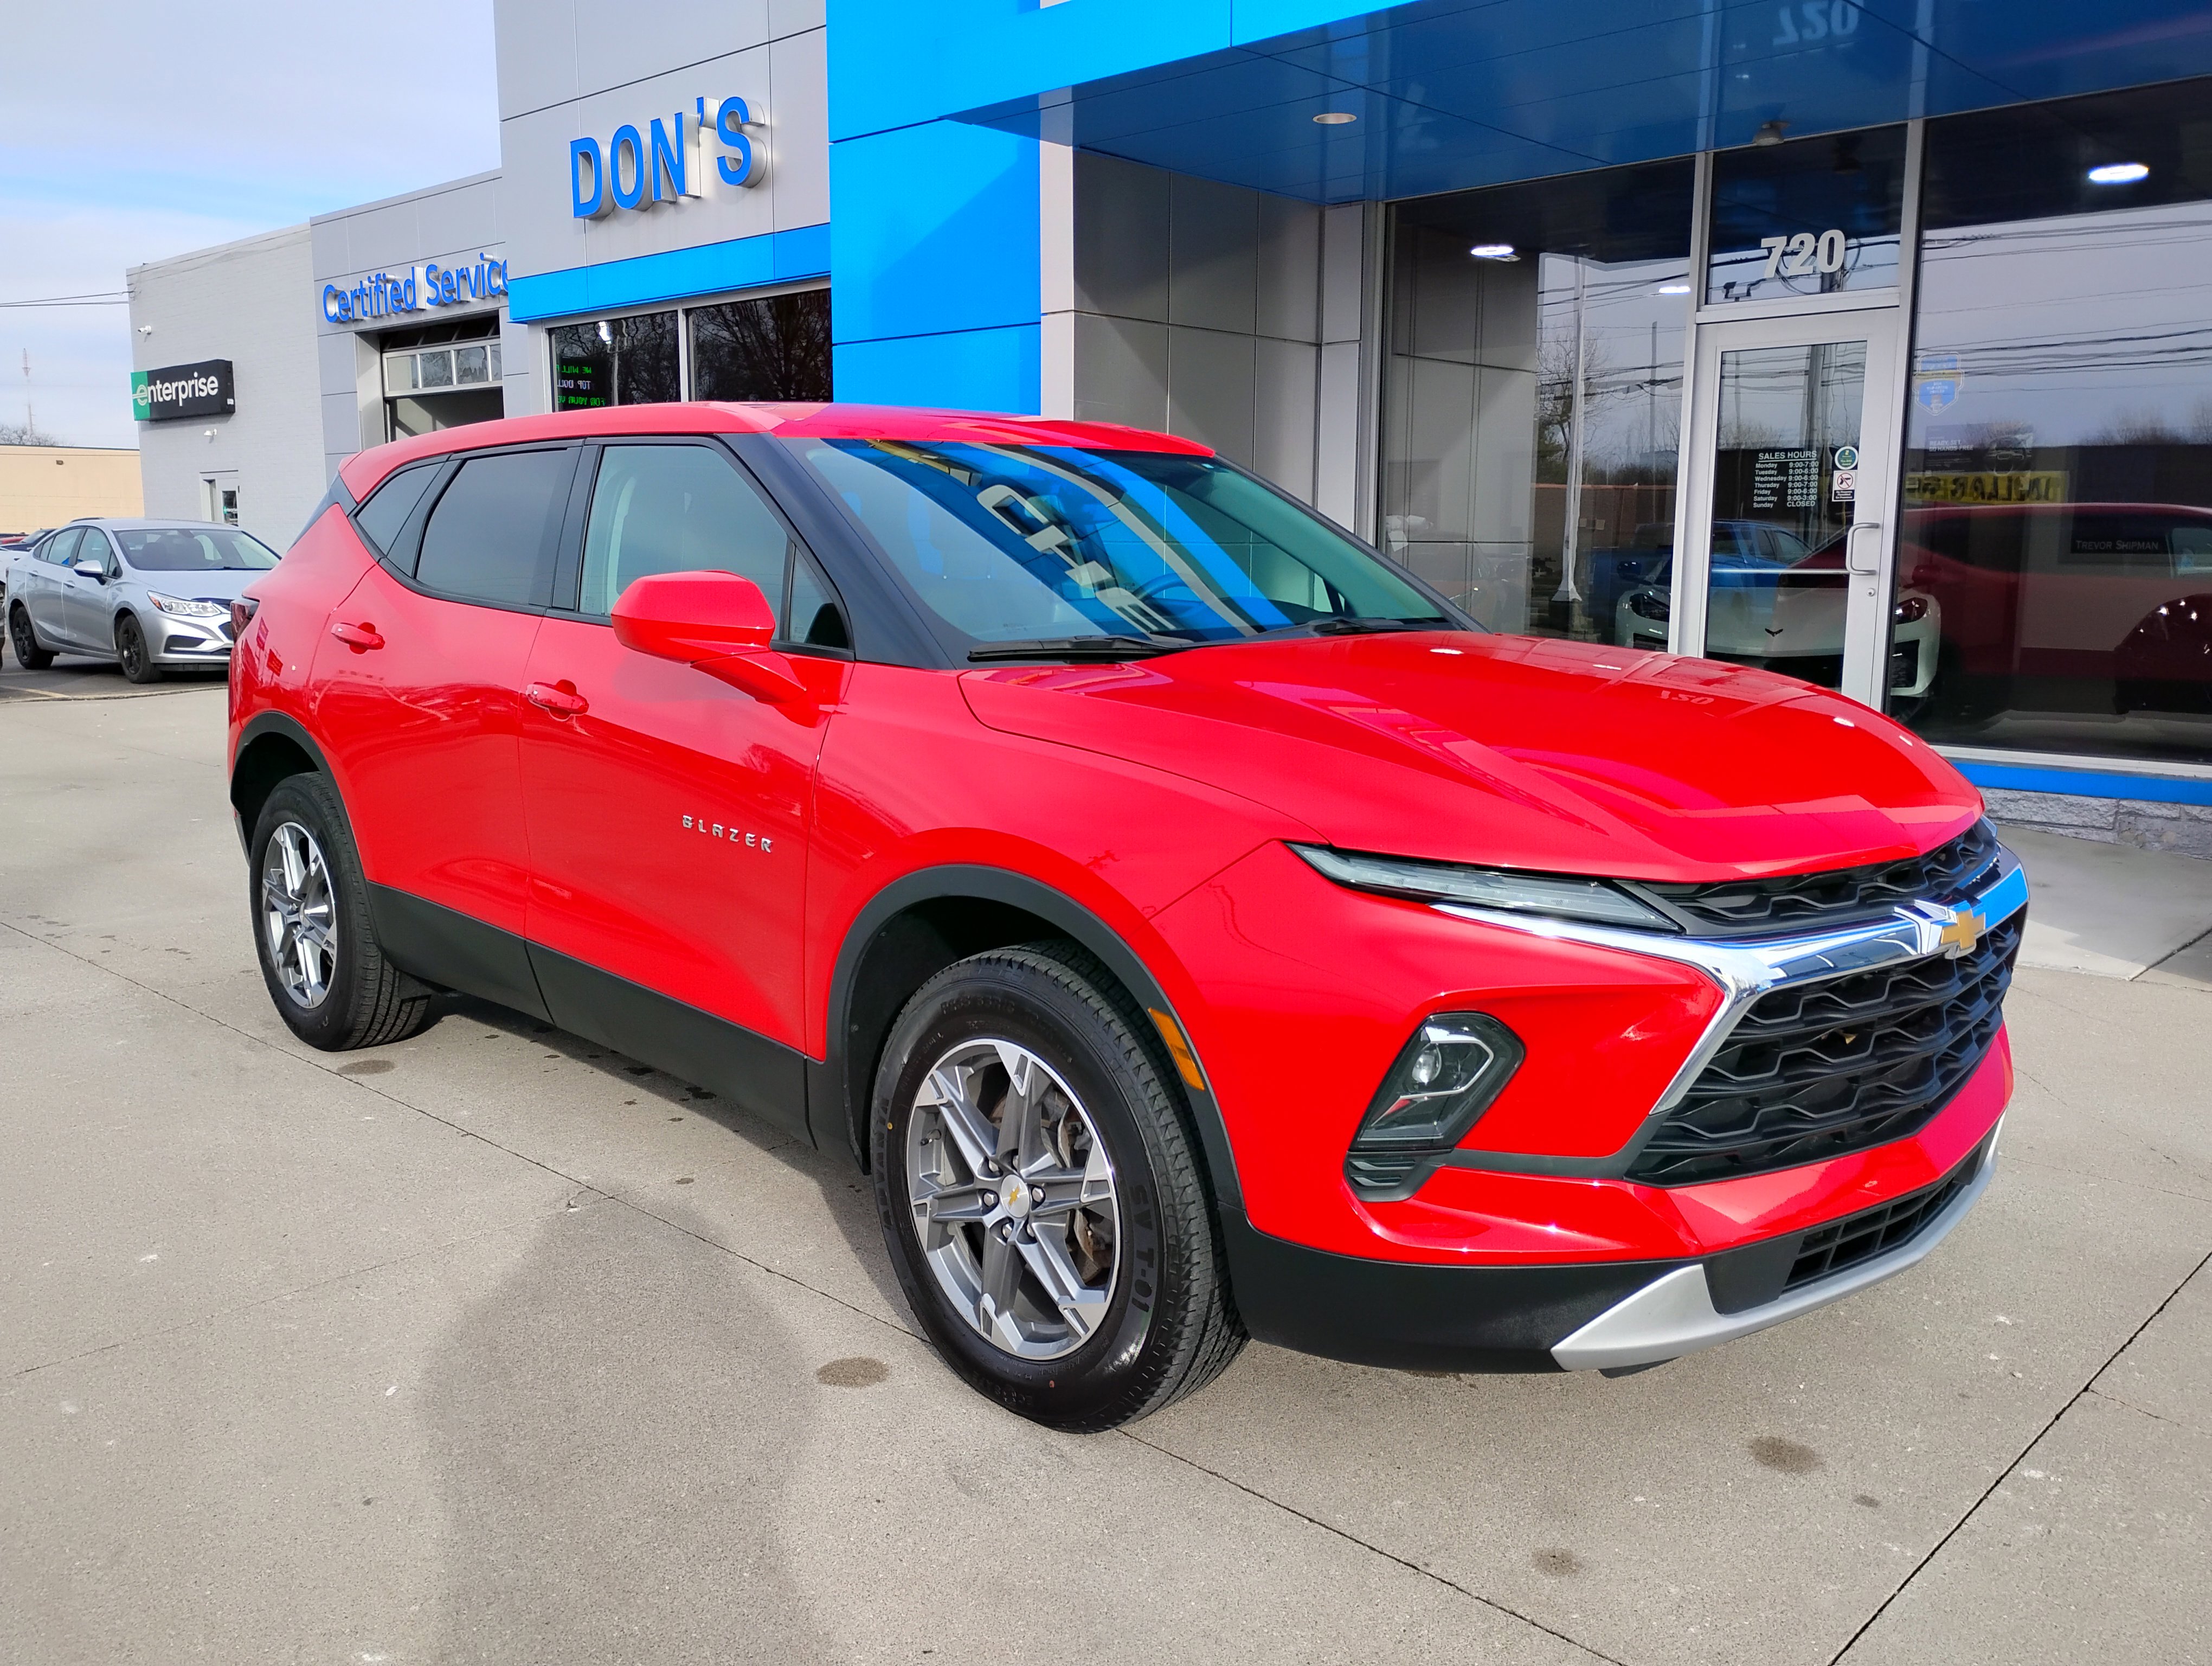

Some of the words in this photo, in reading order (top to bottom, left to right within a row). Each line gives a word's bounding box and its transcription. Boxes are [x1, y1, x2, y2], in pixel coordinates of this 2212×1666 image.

[570, 96, 754, 219] DON'S
[1760, 229, 1846, 278] 720
[323, 267, 417, 324] Certified
[132, 371, 218, 407] enterprise
[1758, 452, 1785, 460] SALES
[1787, 451, 1817, 459] HOURS
[2075, 540, 2112, 550] TREVOR
[2115, 540, 2159, 550] SHIPMAN
[682, 815, 773, 853] BLAZER
[1130, 1185, 1153, 1230] SV
